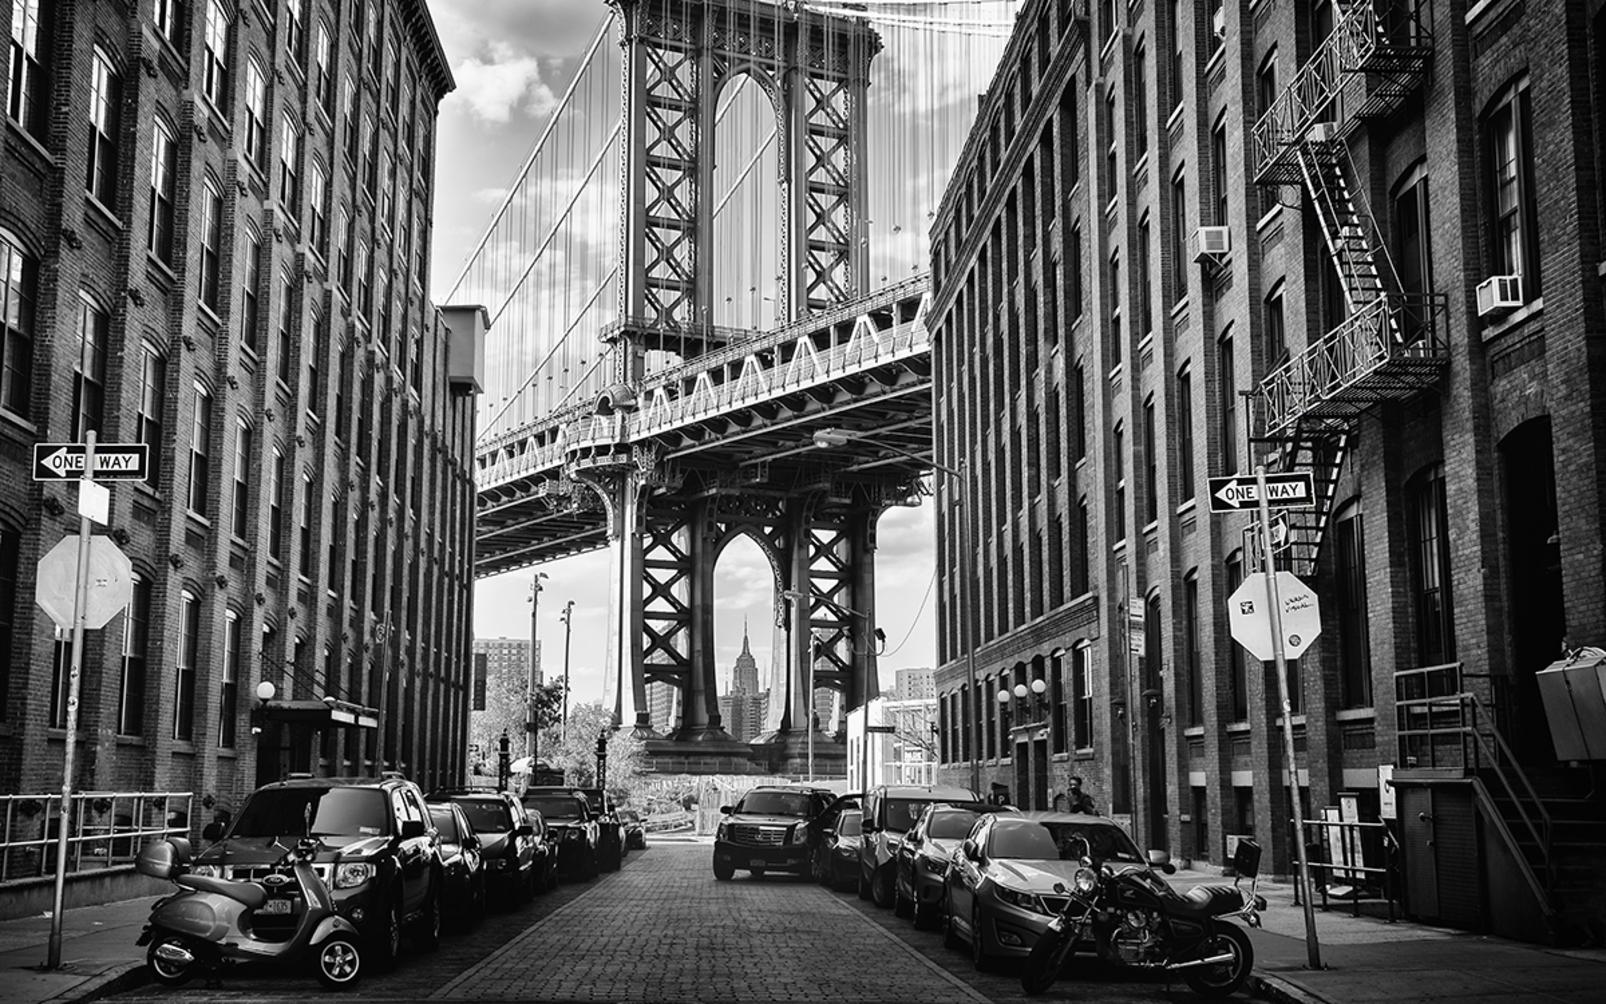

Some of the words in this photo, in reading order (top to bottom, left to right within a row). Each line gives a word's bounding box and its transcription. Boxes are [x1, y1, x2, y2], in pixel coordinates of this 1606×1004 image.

[52, 455, 84, 469] ONE
[99, 455, 133, 469] WAY
[1225, 486, 1255, 500] ONE
[1267, 484, 1299, 497] WAY
